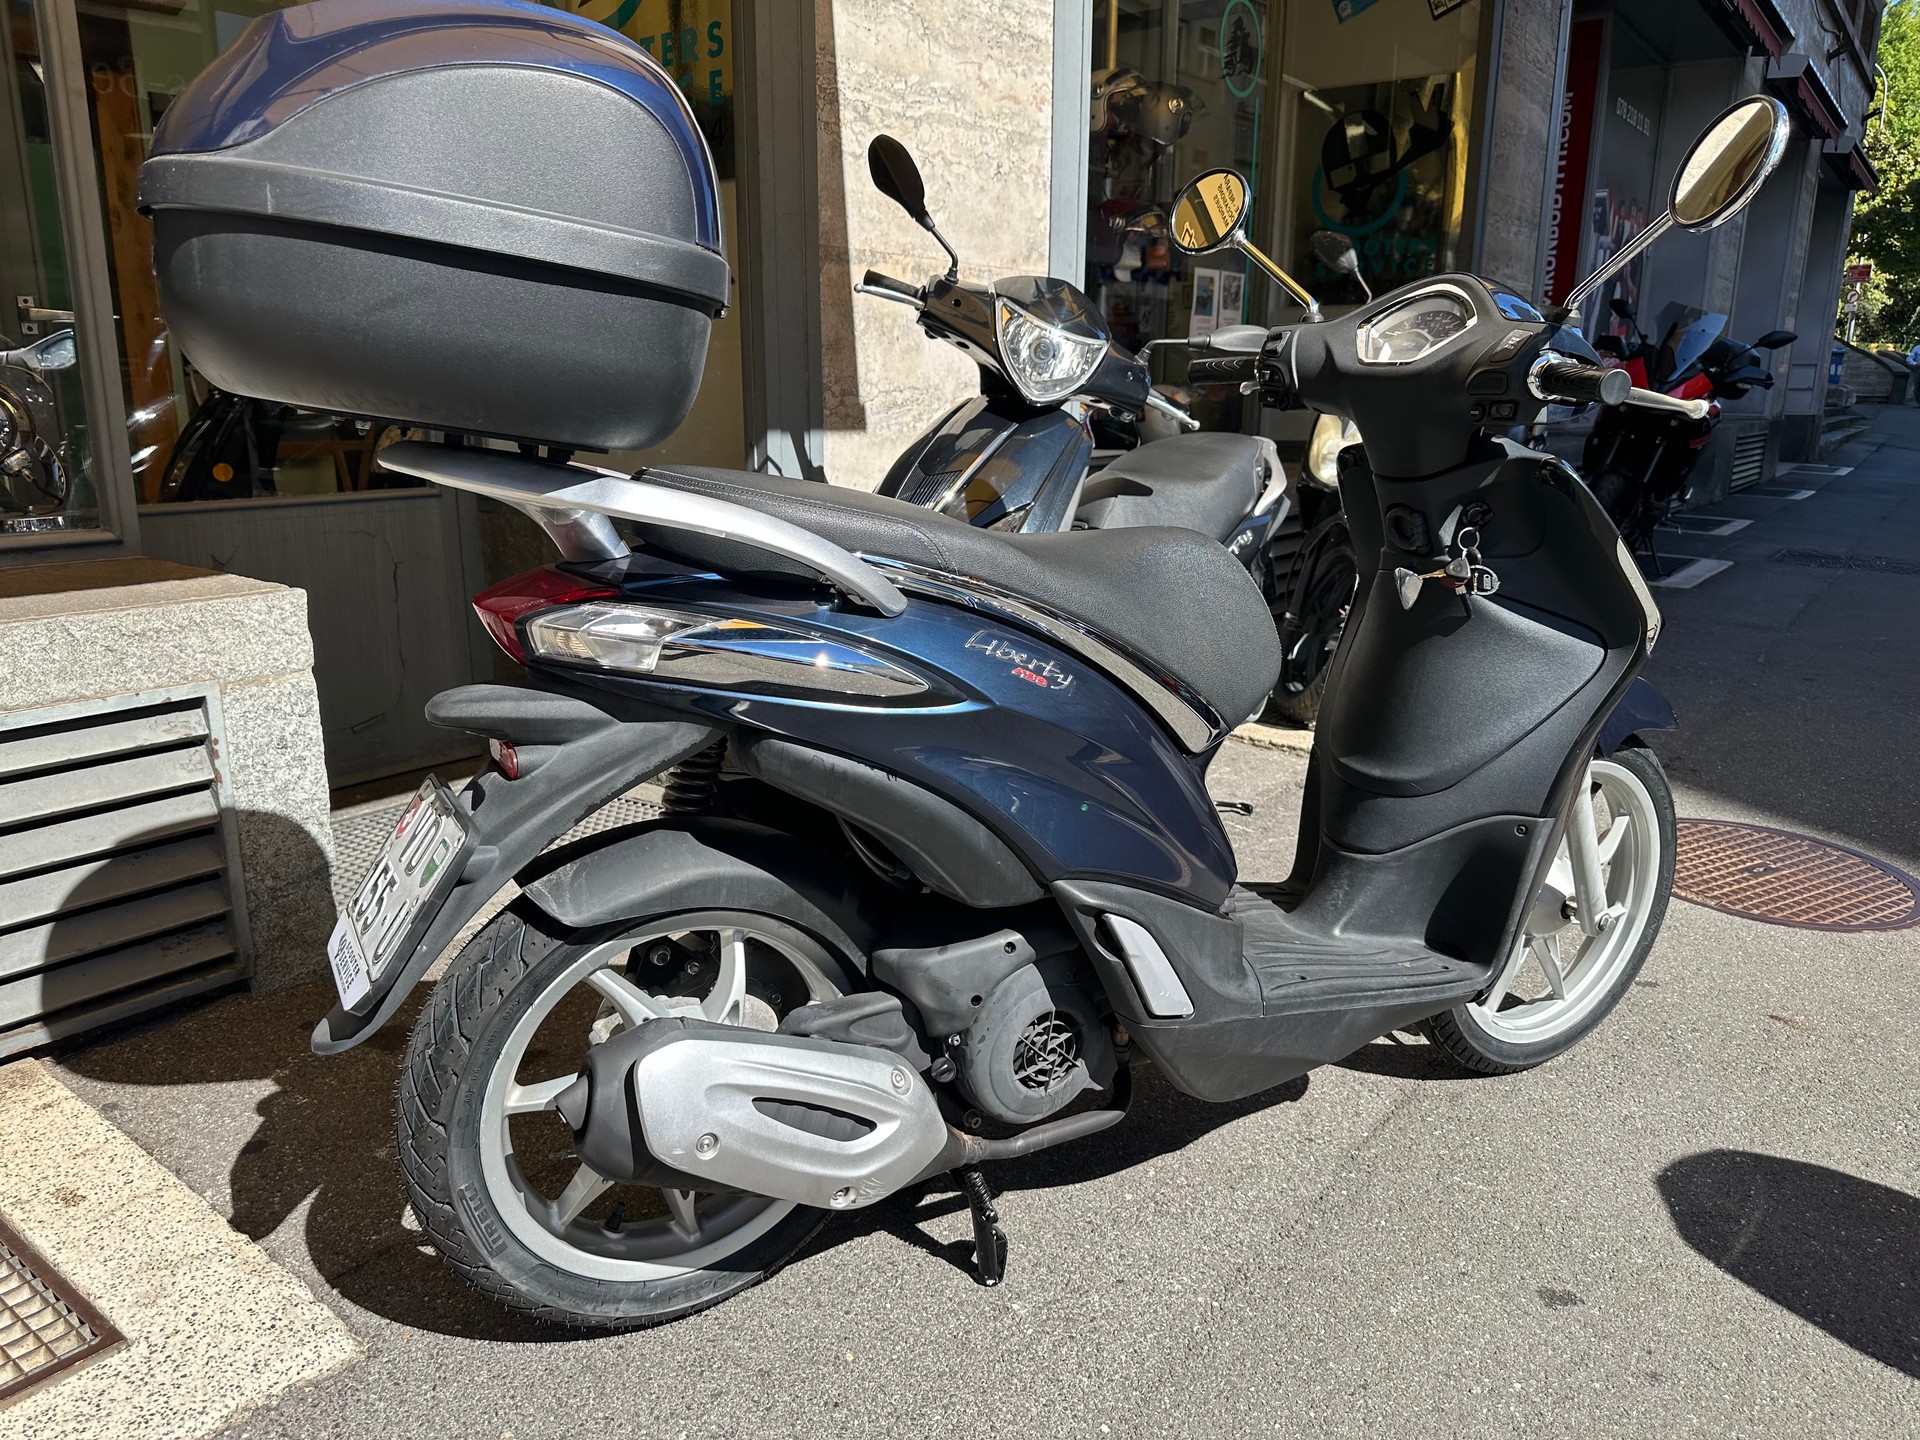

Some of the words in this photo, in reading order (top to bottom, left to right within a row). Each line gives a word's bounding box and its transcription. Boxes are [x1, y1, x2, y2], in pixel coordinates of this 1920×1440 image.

[640, 21, 724, 67] TERS
[1315, 257, 1434, 279] SVICE
[964, 629, 1075, 692] Liberty
[1012, 667, 1048, 688] ABS
[397, 802, 446, 878] VD
[338, 948, 354, 990] SERVICE
[345, 939, 360, 979] SCOOTER
[457, 1181, 507, 1259] PIRELLI
